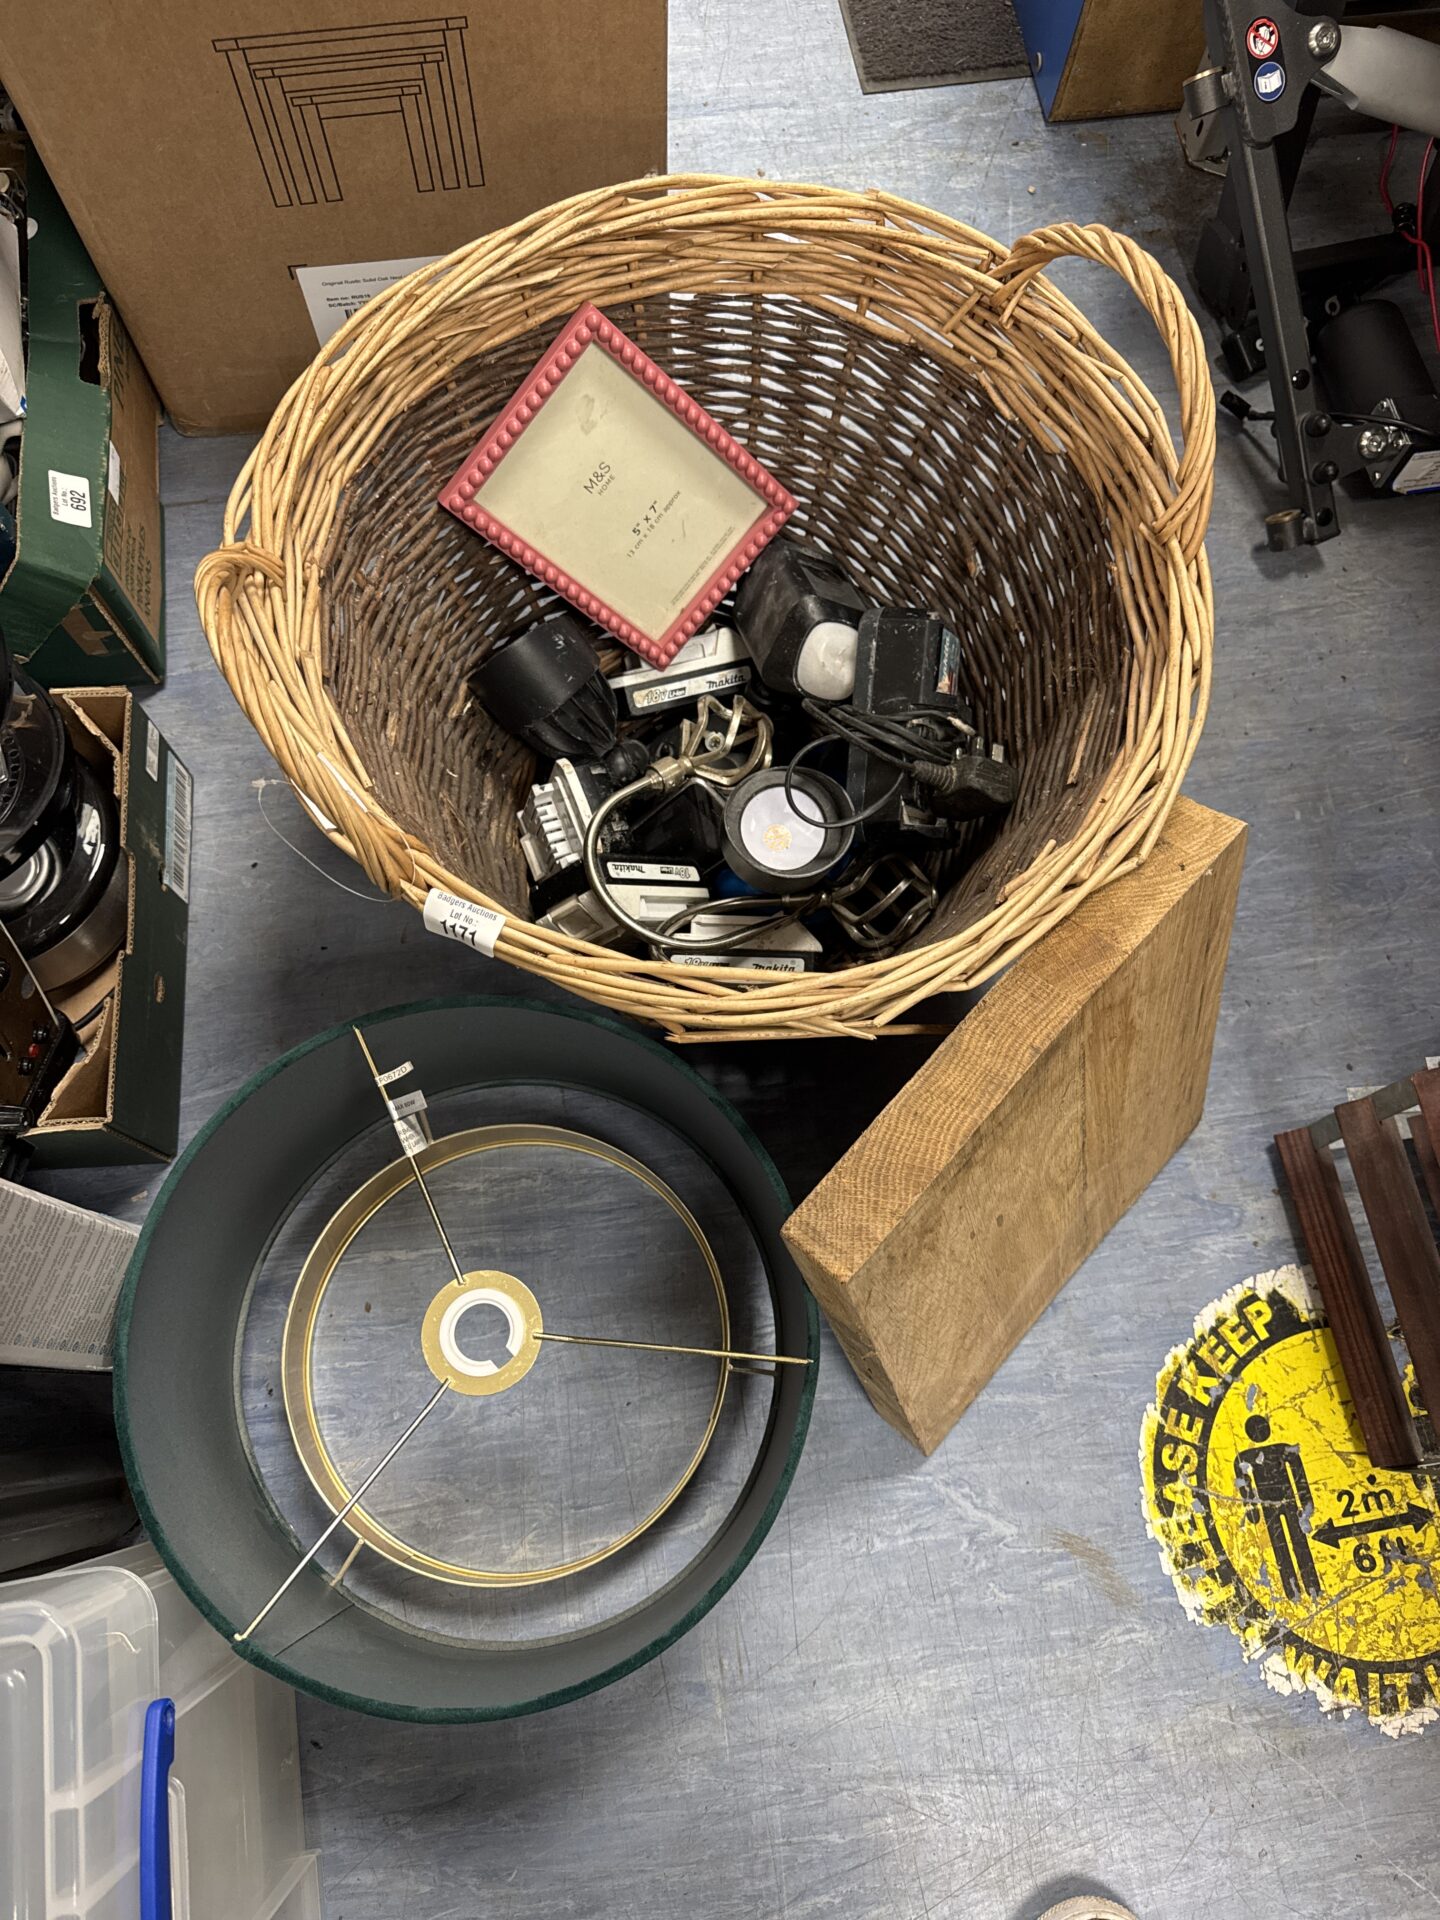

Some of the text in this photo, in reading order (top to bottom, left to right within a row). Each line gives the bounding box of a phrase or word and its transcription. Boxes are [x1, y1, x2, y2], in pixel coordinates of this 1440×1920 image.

[583, 461, 612, 495] M&S
[597, 474, 616, 496] HOME
[69, 490, 87, 511] 692
[634, 538, 644, 550] cm
[654, 512, 664, 524] cm
[663, 490, 681, 514] approx
[706, 674, 745, 689] makita
[612, 863, 646, 873] makita
[437, 892, 498, 921] Badgers Auctions
[450, 908, 463, 920] Lot
[440, 919, 477, 946] 1171
[1161, 1299, 1274, 1610] PLEASE KEEP
[1336, 1484, 1396, 1519] 2m
[1283, 1643, 1416, 1718] WAIT
